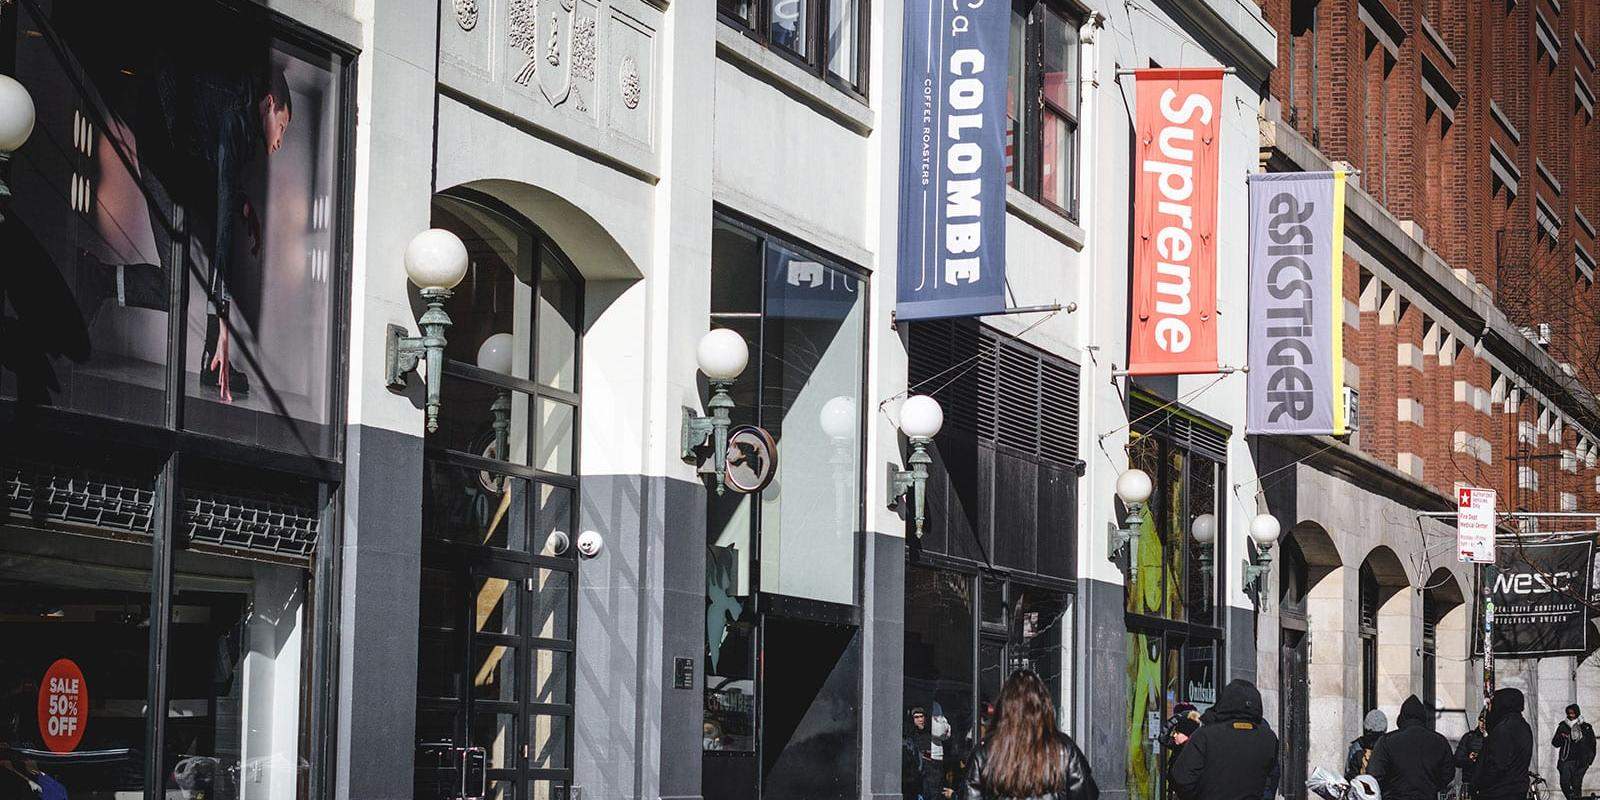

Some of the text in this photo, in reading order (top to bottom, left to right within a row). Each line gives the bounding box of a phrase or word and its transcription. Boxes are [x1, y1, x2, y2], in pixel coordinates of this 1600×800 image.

[922, 79, 932, 186] COFFEE ROASTERS
[945, 49, 985, 286] COLOMBE
[1143, 88, 1213, 353] Supreme
[49, 695, 78, 716] 50%
[50, 678, 79, 694] SALE
[48, 716, 78, 736] OFF
